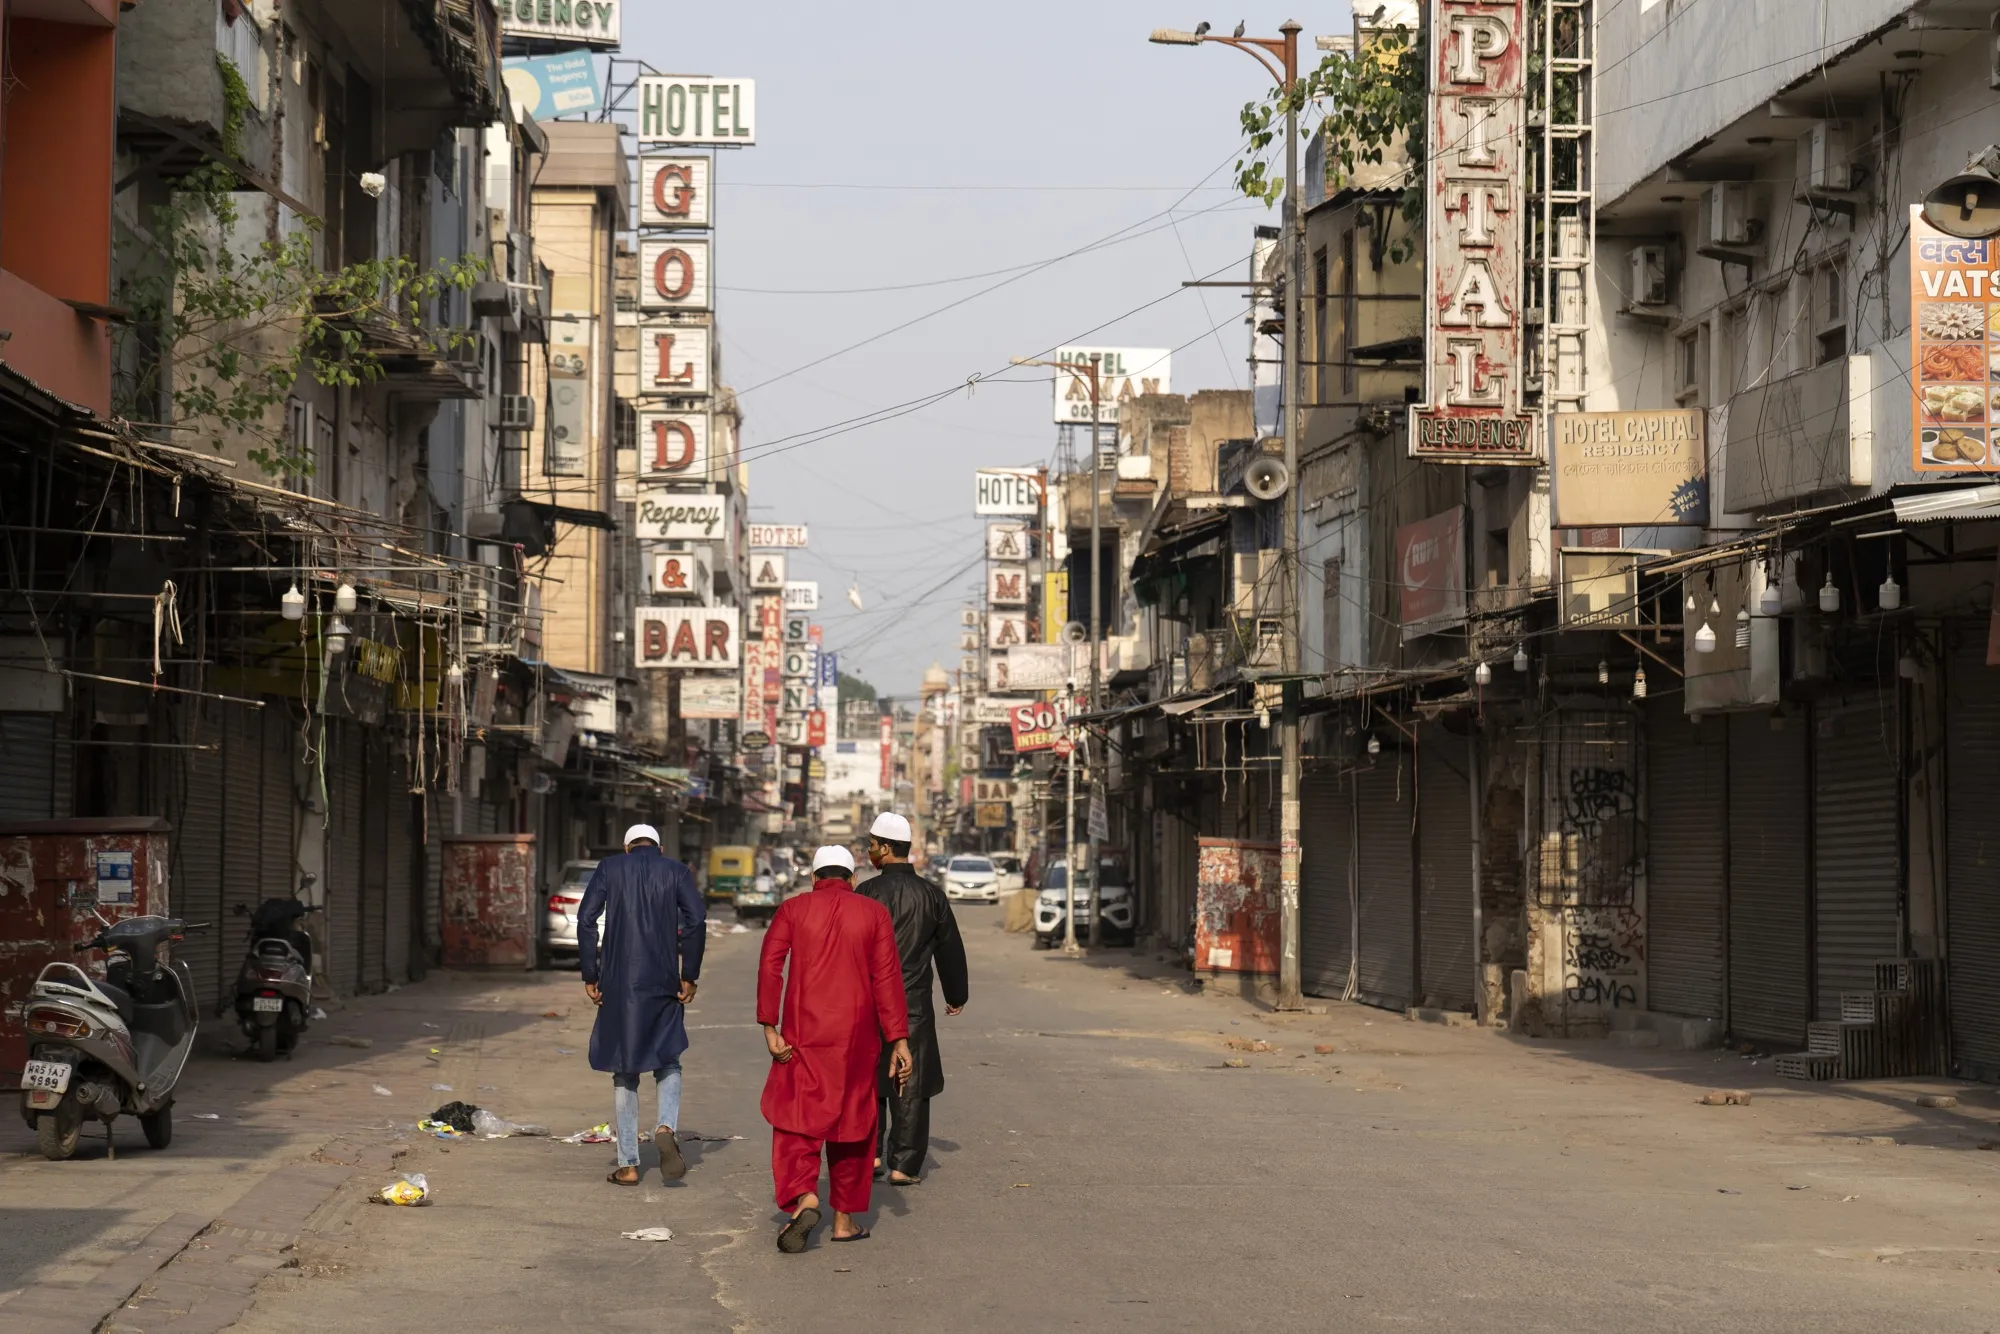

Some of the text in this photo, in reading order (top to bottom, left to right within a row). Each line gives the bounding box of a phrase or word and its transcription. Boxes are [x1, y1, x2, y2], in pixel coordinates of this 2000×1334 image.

[643, 83, 750, 137] HOTEL
[1918, 236, 1992, 265] वत्स
[1420, 417, 1530, 449] RESIDENCY
[1563, 415, 1700, 445] HOTEL CAPITAL
[1583, 443, 1680, 458] RESIDENCY
[978, 477, 1036, 506] HOTEL
[1679, 498, 1701, 513] Free
[638, 499, 721, 536] Regency
[751, 527, 807, 546] HOTEL
[661, 558, 688, 589] &
[1570, 612, 1630, 625] CHEMIST
[642, 618, 730, 662] BAR
[747, 643, 761, 721] KAILASH
